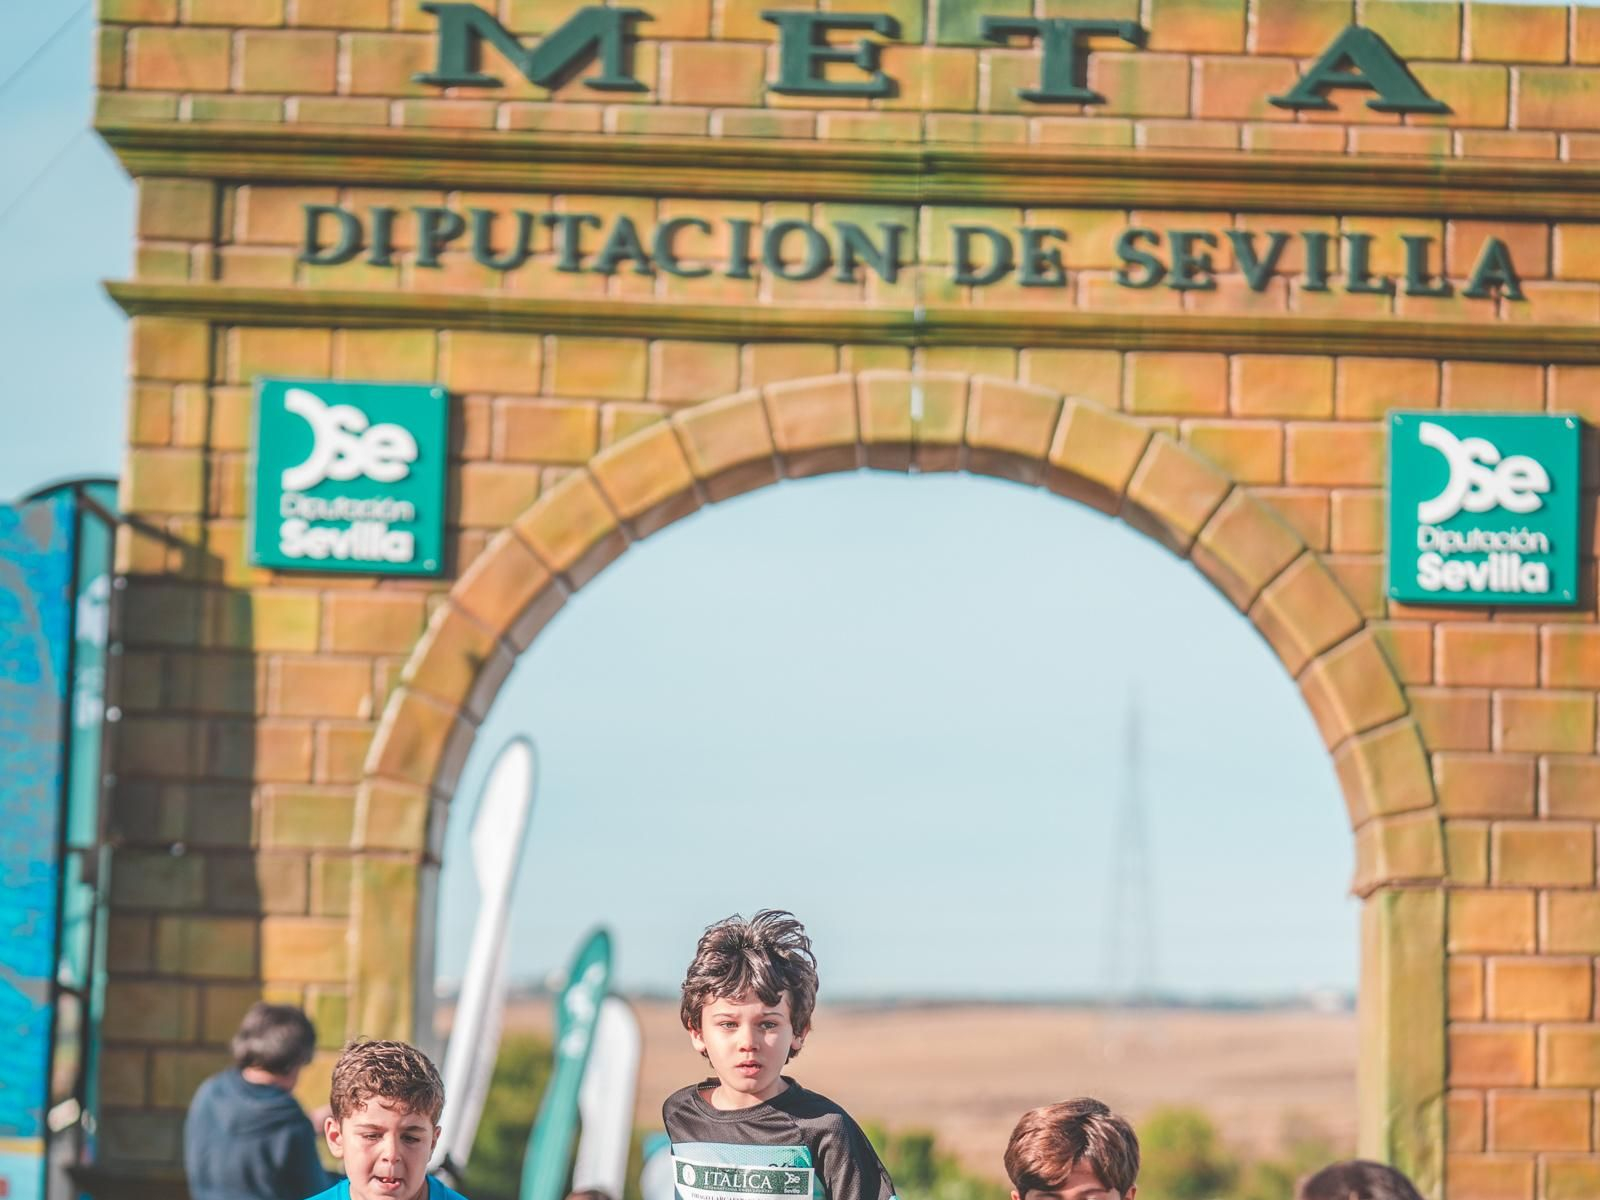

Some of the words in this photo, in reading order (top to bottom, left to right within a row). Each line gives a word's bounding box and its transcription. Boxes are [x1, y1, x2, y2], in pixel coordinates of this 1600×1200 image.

[412, 2, 1453, 115] META
[301, 204, 907, 284] DIPUTACION
[949, 224, 1069, 288] DE
[1114, 229, 1526, 301] SEVILLA
[278, 518, 415, 563] Sevilla
[1417, 526, 1549, 556] Diputación
[1416, 552, 1549, 594] Sevilla
